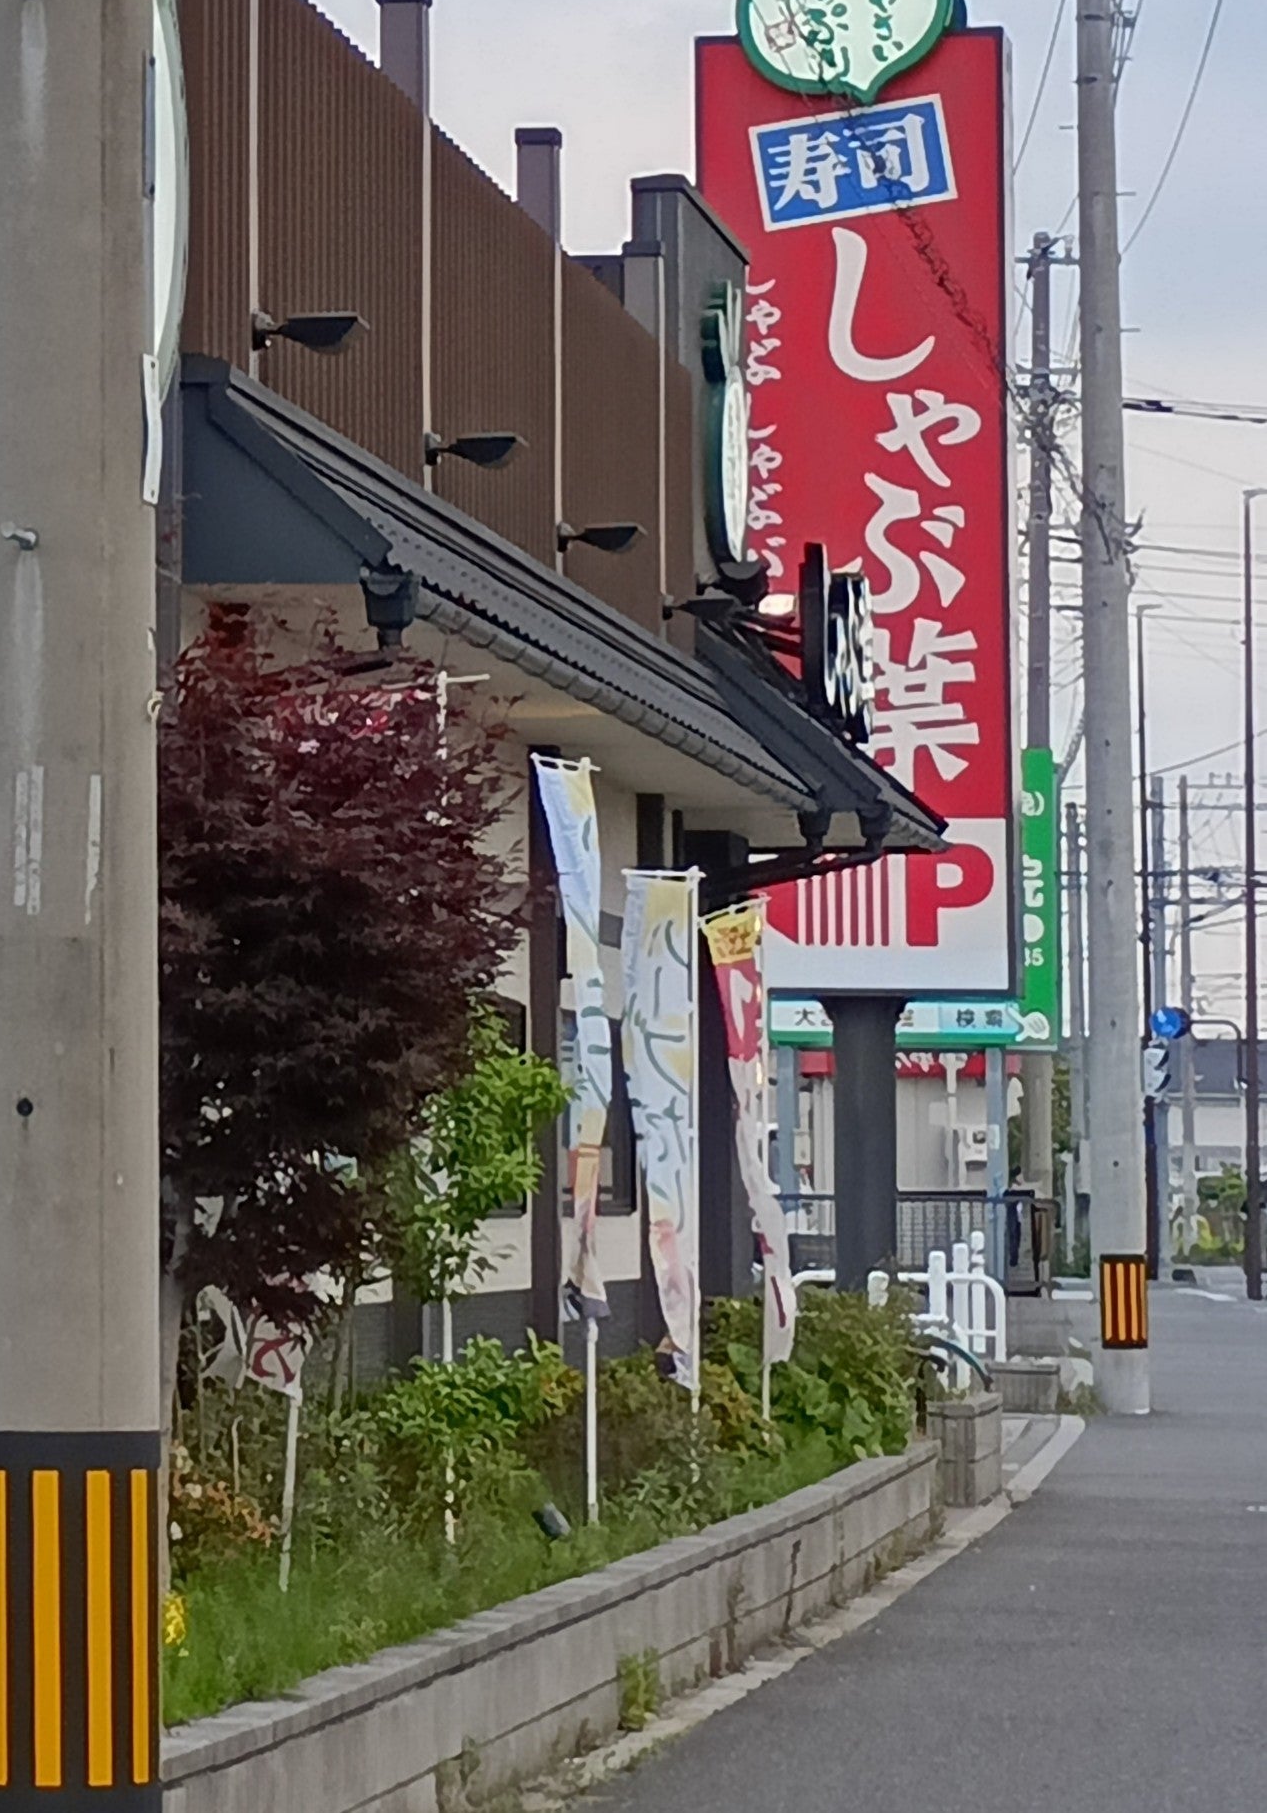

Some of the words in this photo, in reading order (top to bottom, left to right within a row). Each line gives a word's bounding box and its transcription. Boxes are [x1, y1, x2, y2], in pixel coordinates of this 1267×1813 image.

[767, 114, 930, 210] 寿司
[828, 227, 982, 792] しゃぶ葉
[904, 841, 995, 946] P
